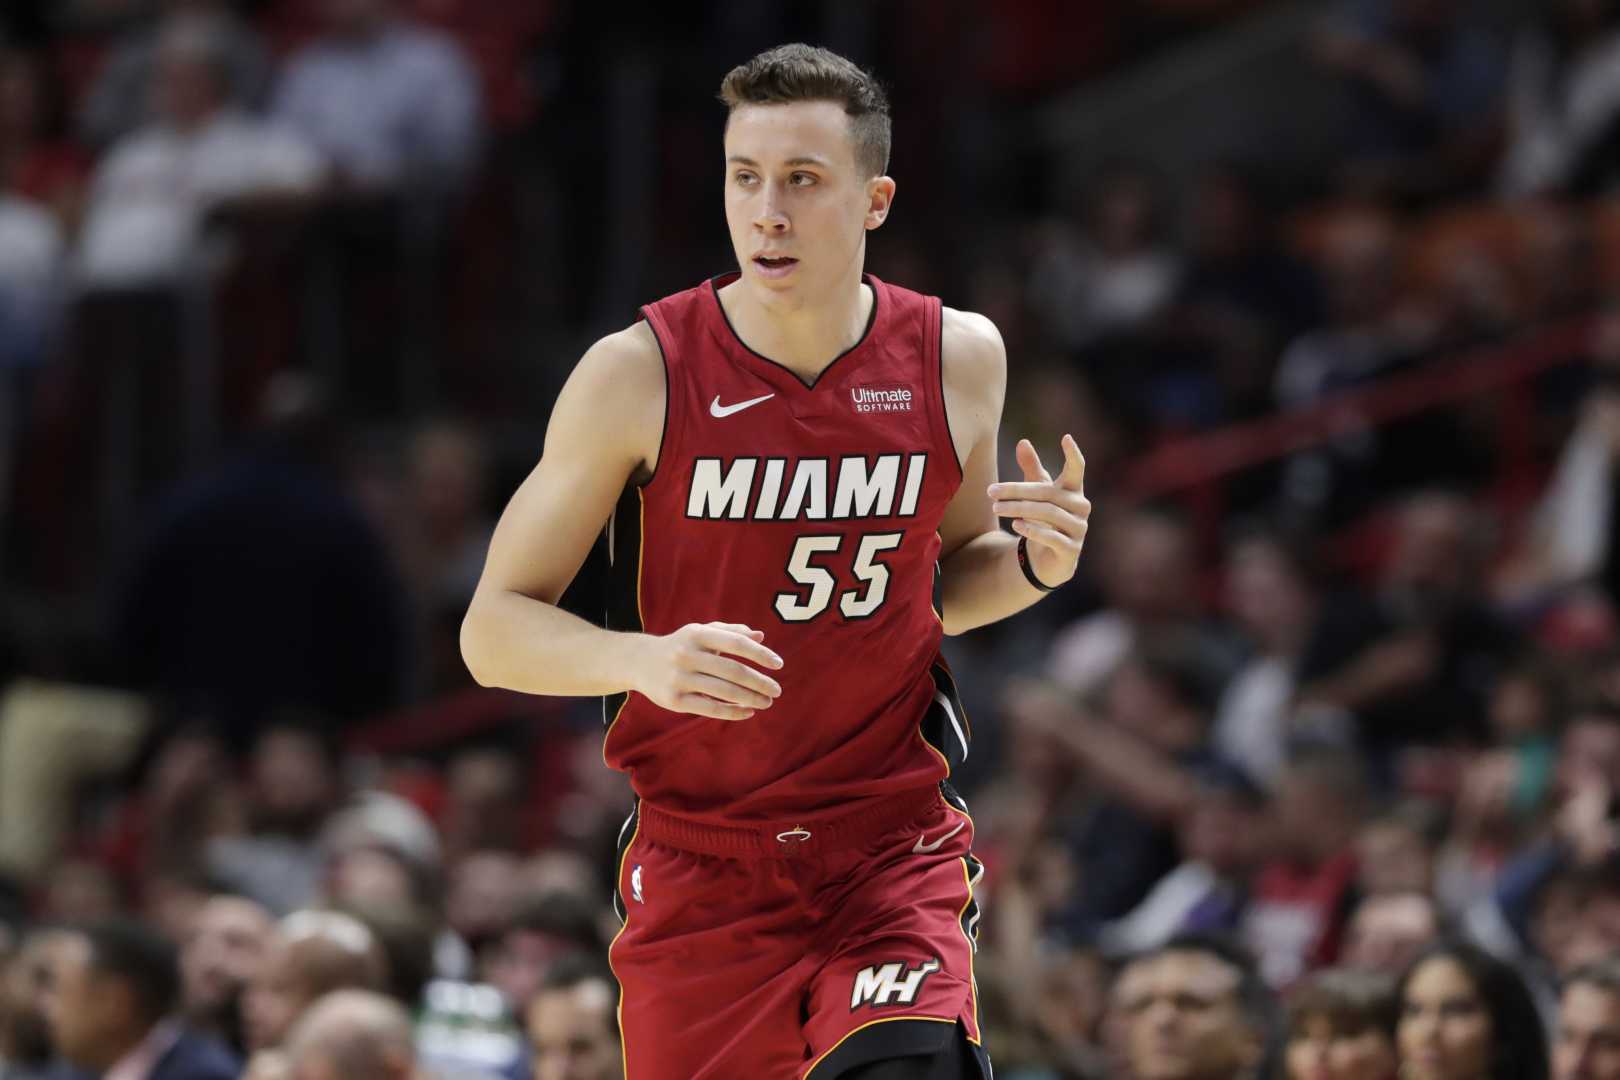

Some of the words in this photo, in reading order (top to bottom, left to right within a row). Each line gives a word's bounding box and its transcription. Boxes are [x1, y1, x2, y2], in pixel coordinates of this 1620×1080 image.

[851, 388, 912, 403] Ultimate
[856, 402, 911, 412] SOFTWARE
[686, 454, 927, 521] MIAMI
[773, 531, 903, 623] 55
